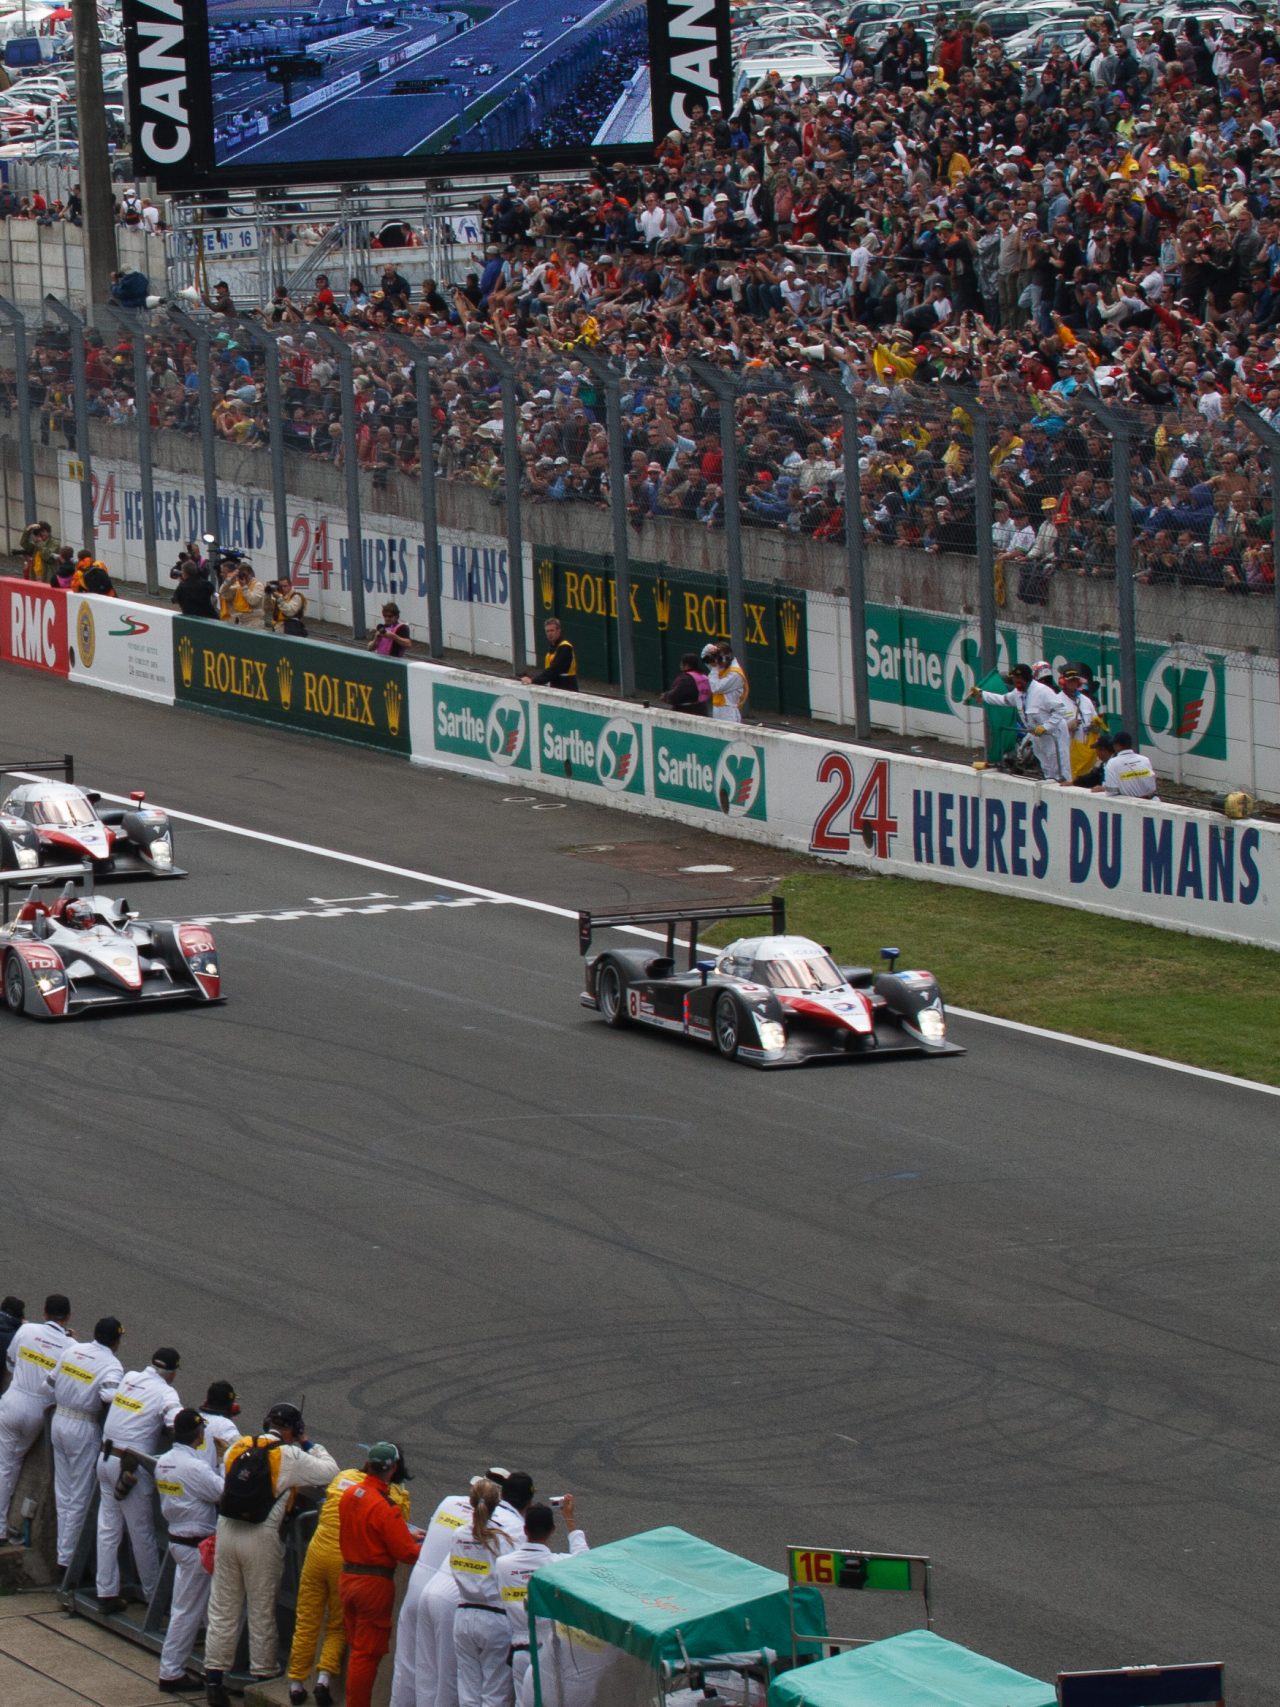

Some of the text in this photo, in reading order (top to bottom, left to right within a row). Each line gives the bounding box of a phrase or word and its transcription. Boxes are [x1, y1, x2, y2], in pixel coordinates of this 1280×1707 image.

[239, 230, 252, 247] 16
[125, 490, 181, 542] HERES
[291, 515, 333, 590] 24
[339, 537, 409, 595] HURES
[452, 546, 509, 604] MANS
[11, 592, 56, 668] RMC
[866, 629, 942, 690] Sarthe
[203, 649, 376, 727] ROLEX ROLEX
[437, 700, 485, 744] Sarthe
[543, 722, 595, 768] Sarthe
[658, 745, 713, 793] Sarthe
[809, 750, 1260, 905] 24 HEURES DU MANS
[28, 959, 57, 969] TDI
[186, 943, 215, 954] TDI
[629, 991, 638, 1016] 8
[453, 1559, 487, 1571] DUNLOP
[800, 1552, 833, 1583] 16
